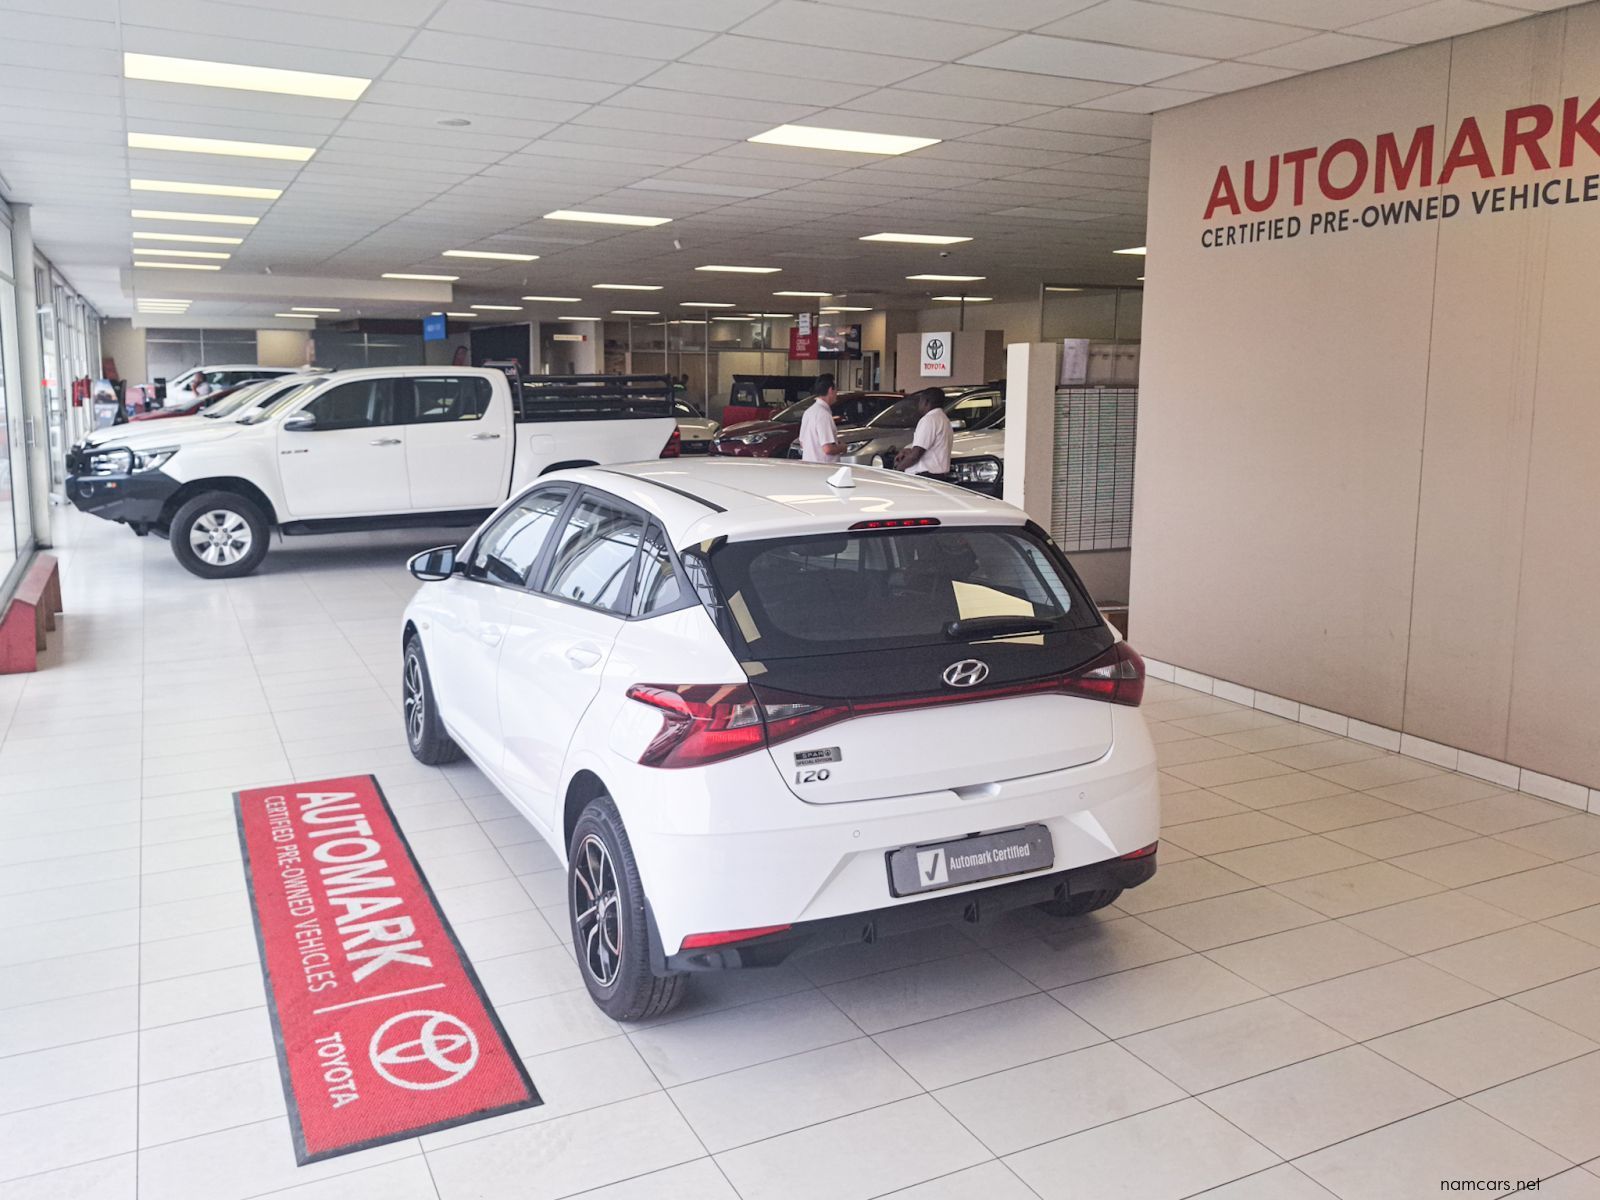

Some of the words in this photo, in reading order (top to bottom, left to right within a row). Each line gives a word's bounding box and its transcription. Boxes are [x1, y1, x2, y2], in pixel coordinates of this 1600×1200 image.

[1203, 96, 1600, 220] AUTOMARK
[1201, 216, 1301, 248] CERTIFIED
[1310, 194, 1460, 235] PRE-OWNED
[263, 795, 293, 844] CERTIFIED
[950, 850, 992, 870] Automark
[993, 843, 1030, 861] Certified
[275, 844, 313, 917] PRE-OWNED
[296, 791, 433, 983] AUTOMARK
[295, 917, 337, 993] VEHICLES
[314, 1032, 359, 1108] TOYOTA
